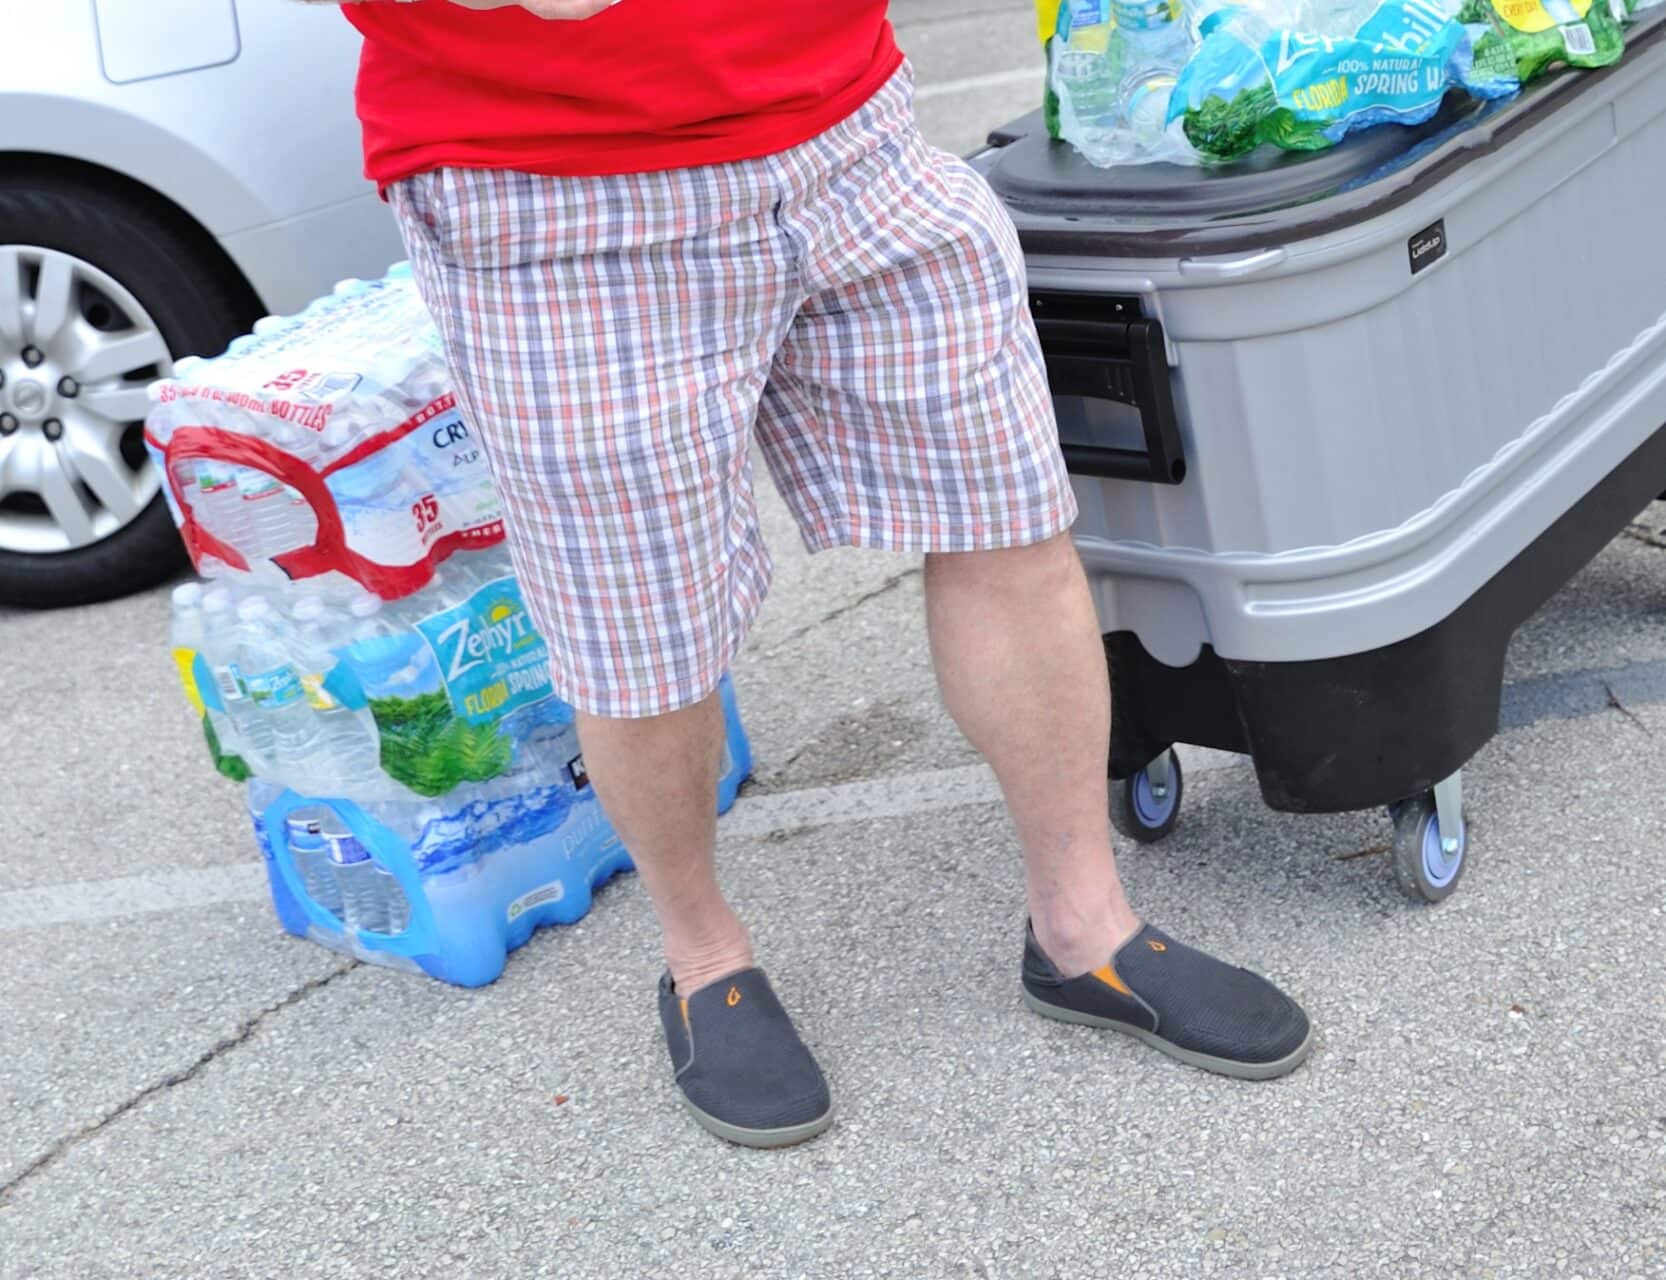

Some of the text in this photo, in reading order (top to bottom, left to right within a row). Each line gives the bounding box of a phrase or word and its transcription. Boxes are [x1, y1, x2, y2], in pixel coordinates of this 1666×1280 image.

[1337, 59, 1369, 74] 100%
[1354, 72, 1419, 96] SPRING
[411, 493, 439, 534] 35
